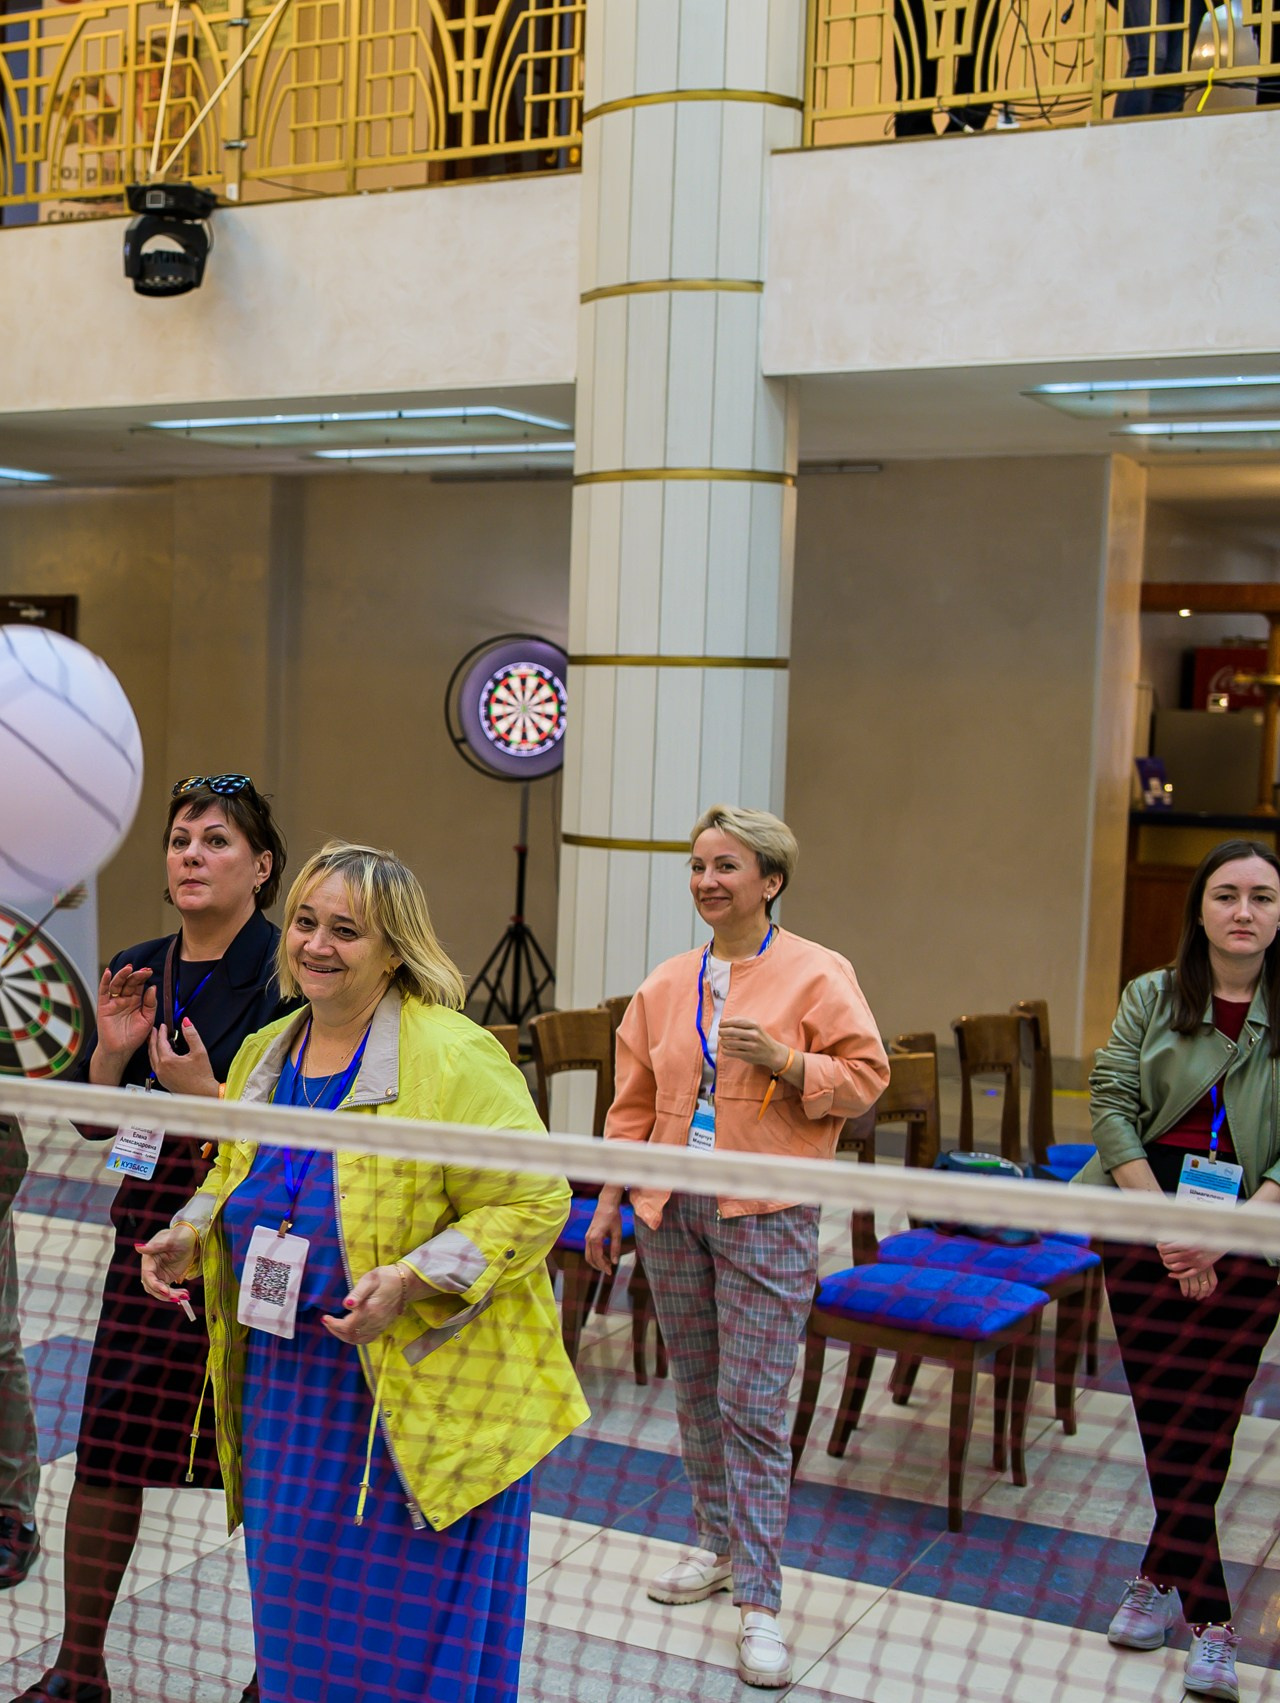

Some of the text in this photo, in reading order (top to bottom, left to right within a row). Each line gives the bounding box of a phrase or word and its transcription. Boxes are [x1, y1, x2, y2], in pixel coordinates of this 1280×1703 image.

[132, 1131, 148, 1141] Елена
[119, 1136, 157, 1151] Александровна
[120, 1161, 149, 1174] КУЗБАСС
